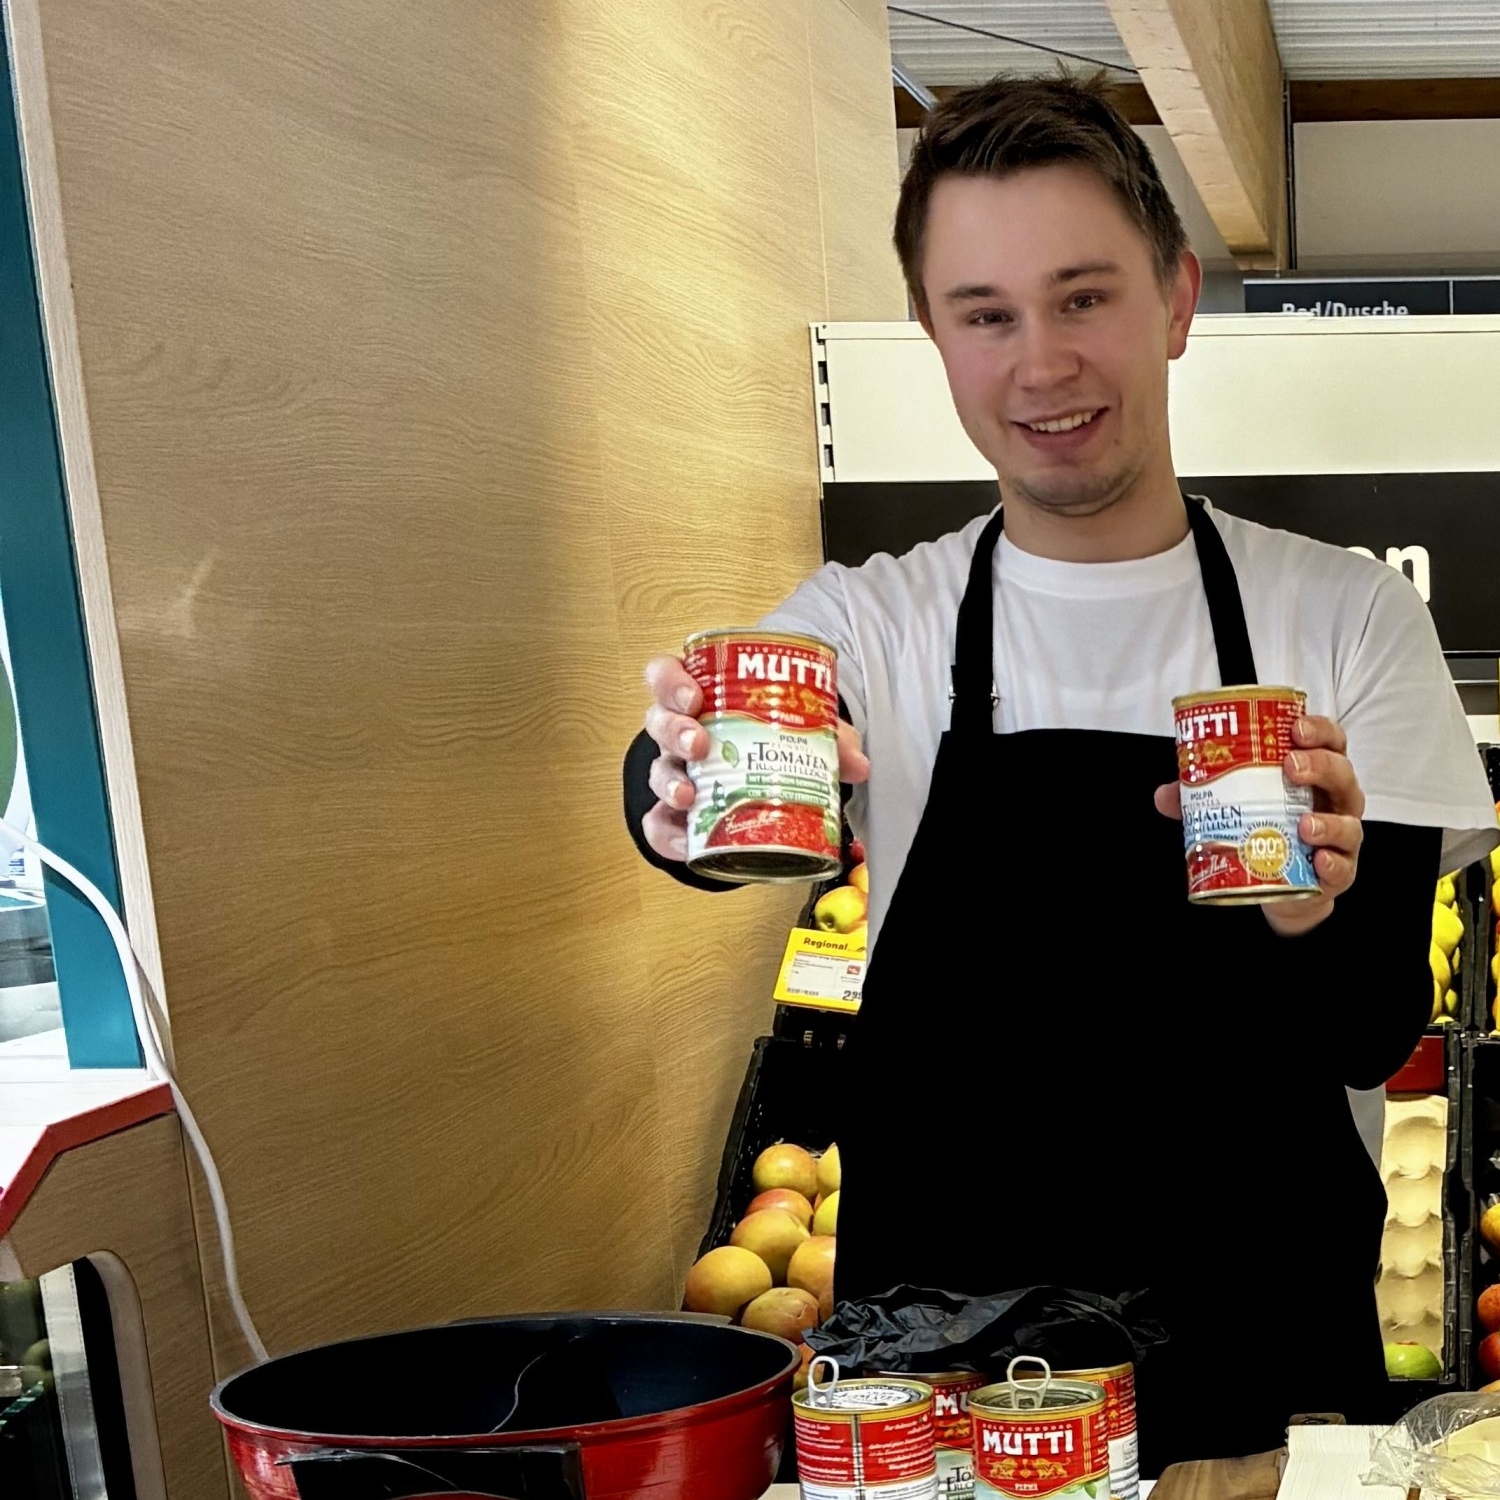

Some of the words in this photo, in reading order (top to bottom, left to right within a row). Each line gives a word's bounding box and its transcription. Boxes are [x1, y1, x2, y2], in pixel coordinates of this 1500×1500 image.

[737, 652, 832, 692] MUTTI
[803, 936, 848, 951] Regional
[982, 1429, 1074, 1456] MUTTI
